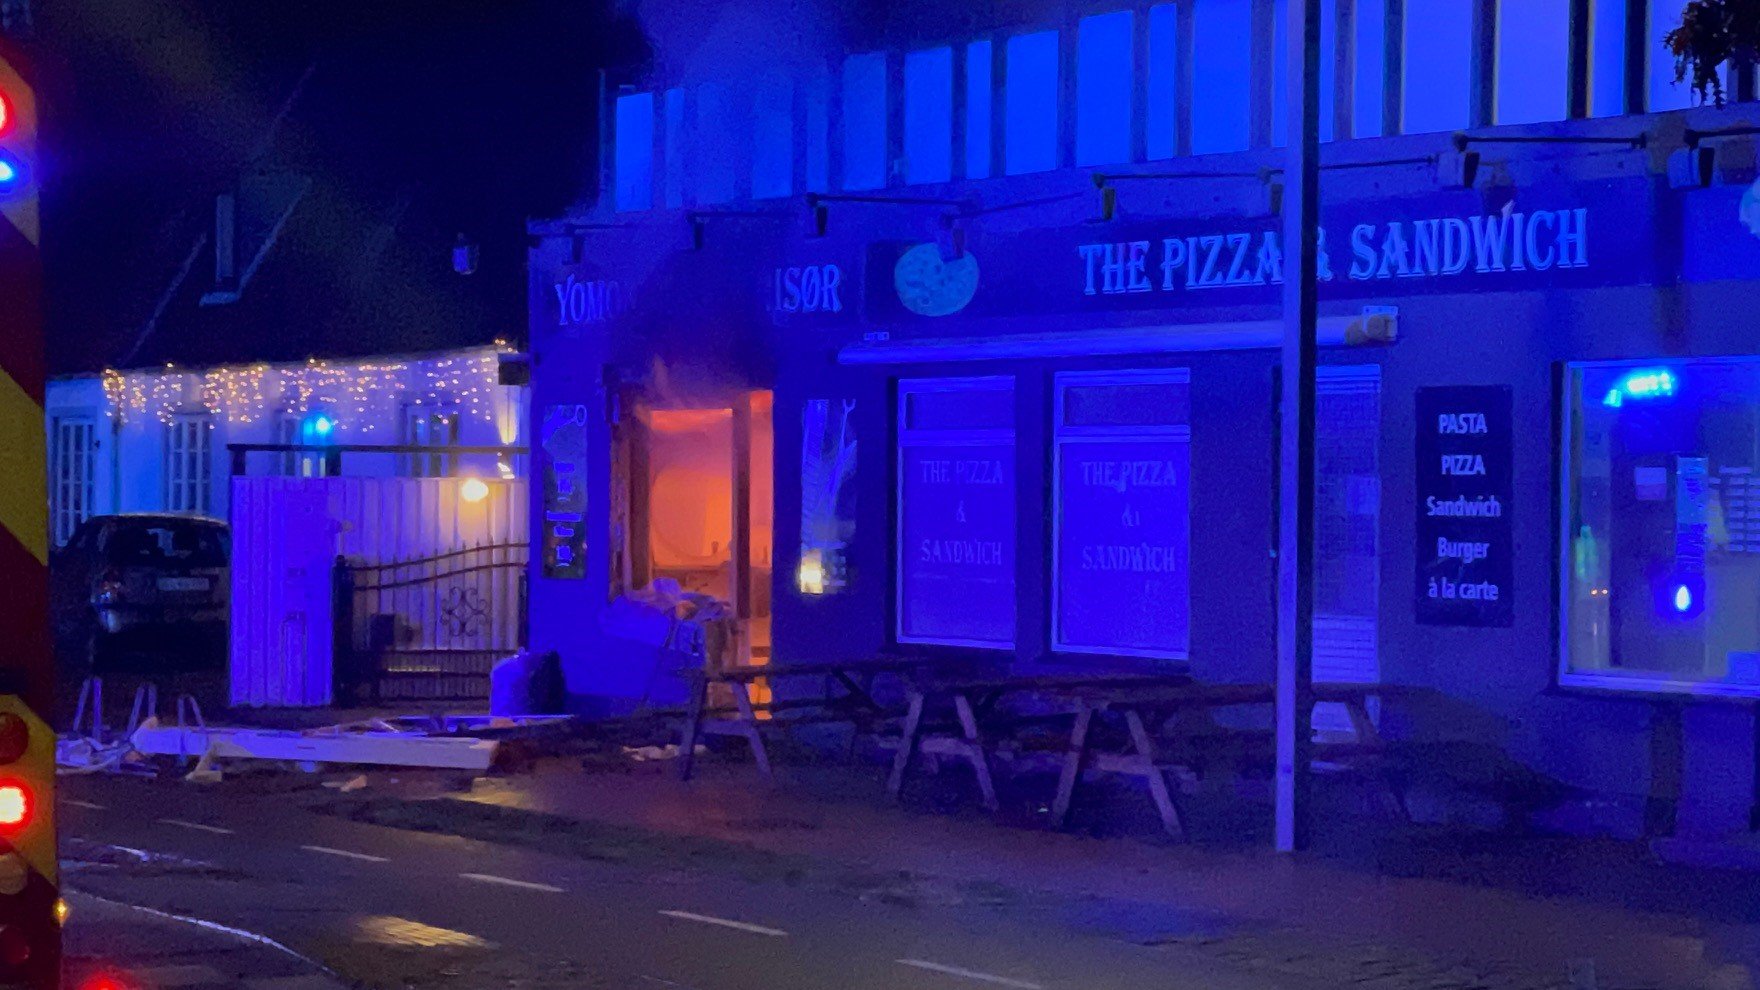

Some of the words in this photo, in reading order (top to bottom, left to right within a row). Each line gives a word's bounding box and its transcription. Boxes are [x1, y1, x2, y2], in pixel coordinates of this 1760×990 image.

[1078, 239, 1152, 296] THE
[1160, 230, 1283, 291] PIZZA
[1348, 205, 1589, 282] SANDWICH
[1438, 413, 1488, 434] PASTA
[919, 460, 950, 484] THE
[956, 460, 1004, 485] PIZZA
[1081, 460, 1113, 486] THE
[1118, 460, 1177, 487] PIZZA
[1440, 454, 1486, 476] PIZZA
[1426, 495, 1502, 517] Sandwich
[920, 538, 1003, 566] SANDWICH
[1081, 542, 1176, 573] SANDWICH
[1437, 536, 1490, 563] Burger
[1441, 576, 1456, 598] la
[1459, 580, 1499, 600] carte
